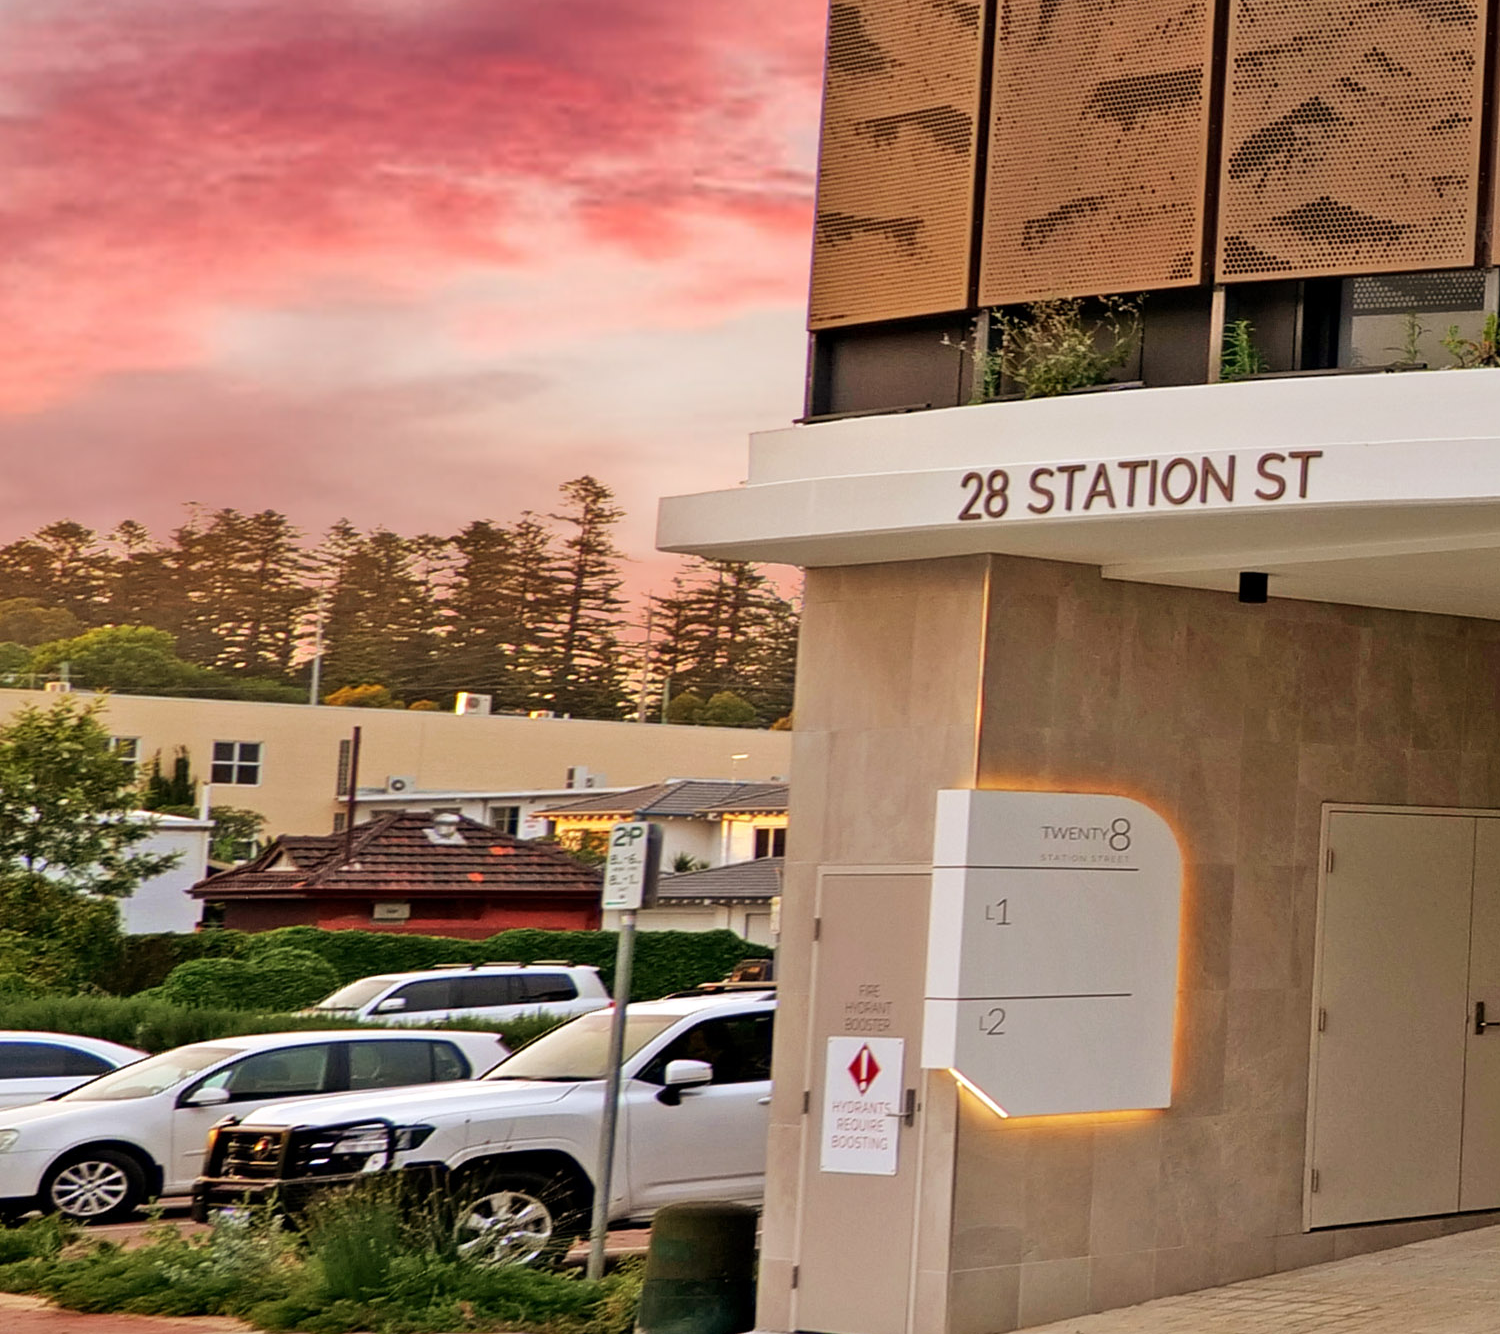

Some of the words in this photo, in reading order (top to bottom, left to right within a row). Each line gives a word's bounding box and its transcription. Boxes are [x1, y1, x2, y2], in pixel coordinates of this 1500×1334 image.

[958, 470, 1010, 520] 28
[1027, 454, 1237, 515] STATION
[1254, 450, 1323, 501] ST
[613, 826, 644, 846] 2P
[859, 984, 880, 998] FIRE
[844, 1001, 893, 1015] HYDRANT
[844, 1017, 890, 1031] BOOSTER
[832, 1101, 892, 1115] HYDRANTS
[836, 1118, 885, 1133] REQUIRE
[831, 1135, 888, 1150] BOOSTING
